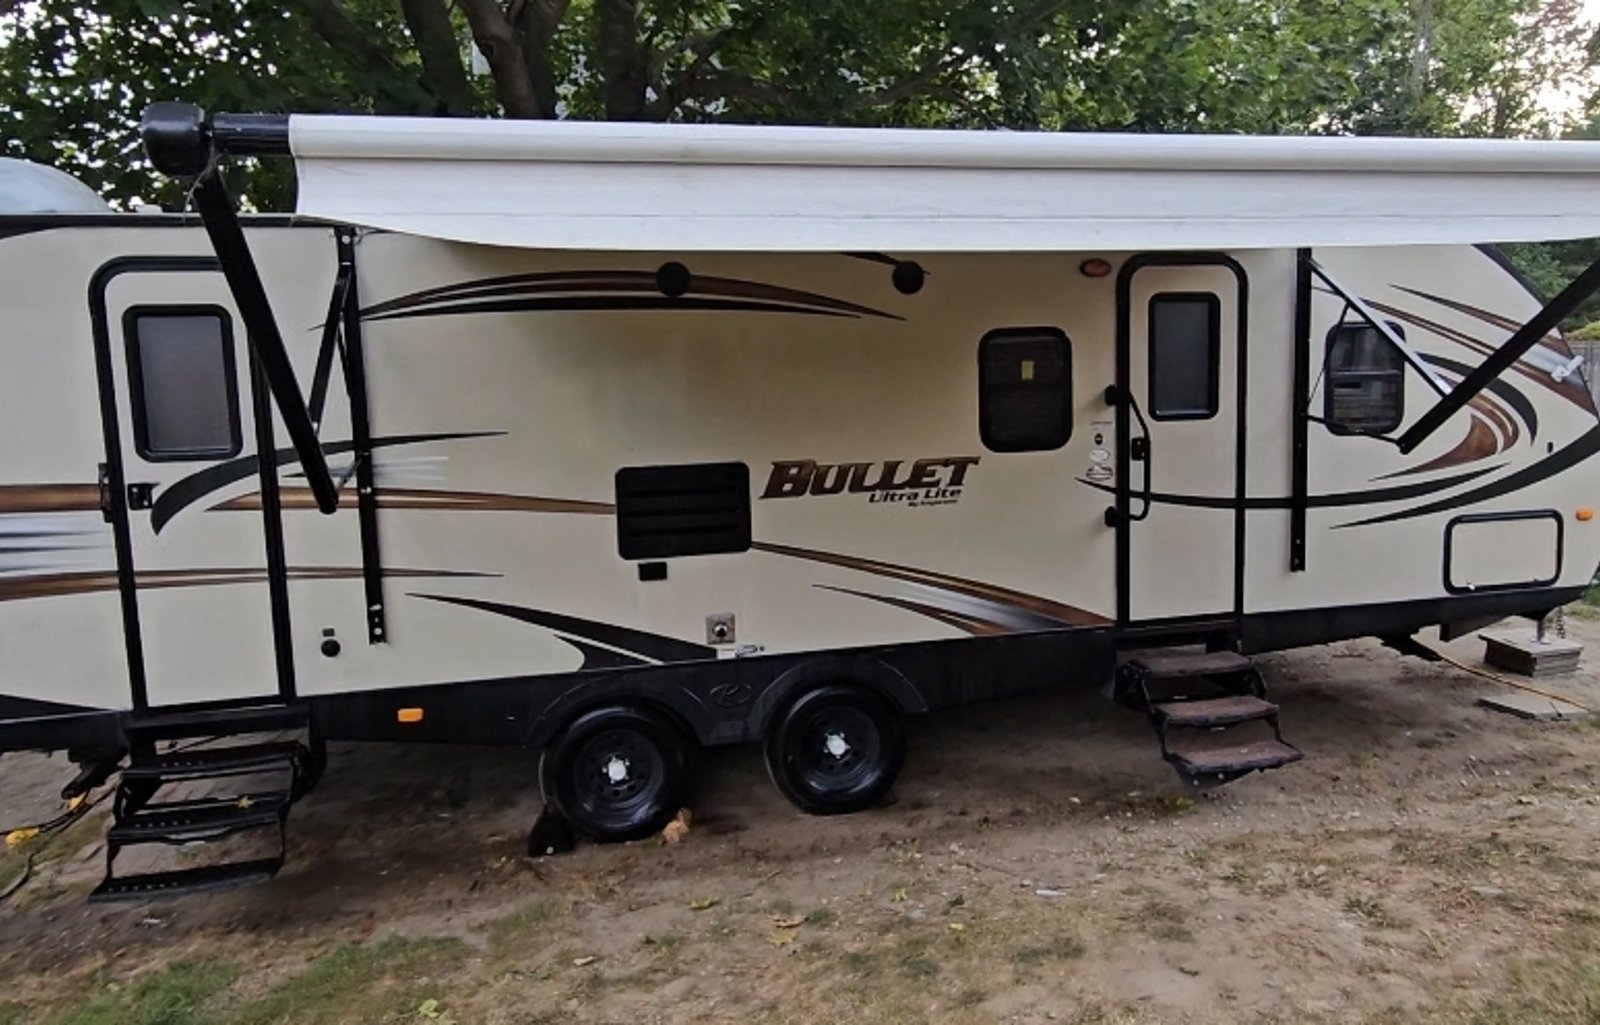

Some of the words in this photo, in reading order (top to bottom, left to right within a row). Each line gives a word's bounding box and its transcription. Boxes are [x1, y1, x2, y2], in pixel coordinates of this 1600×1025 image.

[759, 456, 981, 500] BULLET
[869, 491, 920, 503] Ultra
[924, 488, 963, 500] Lite
